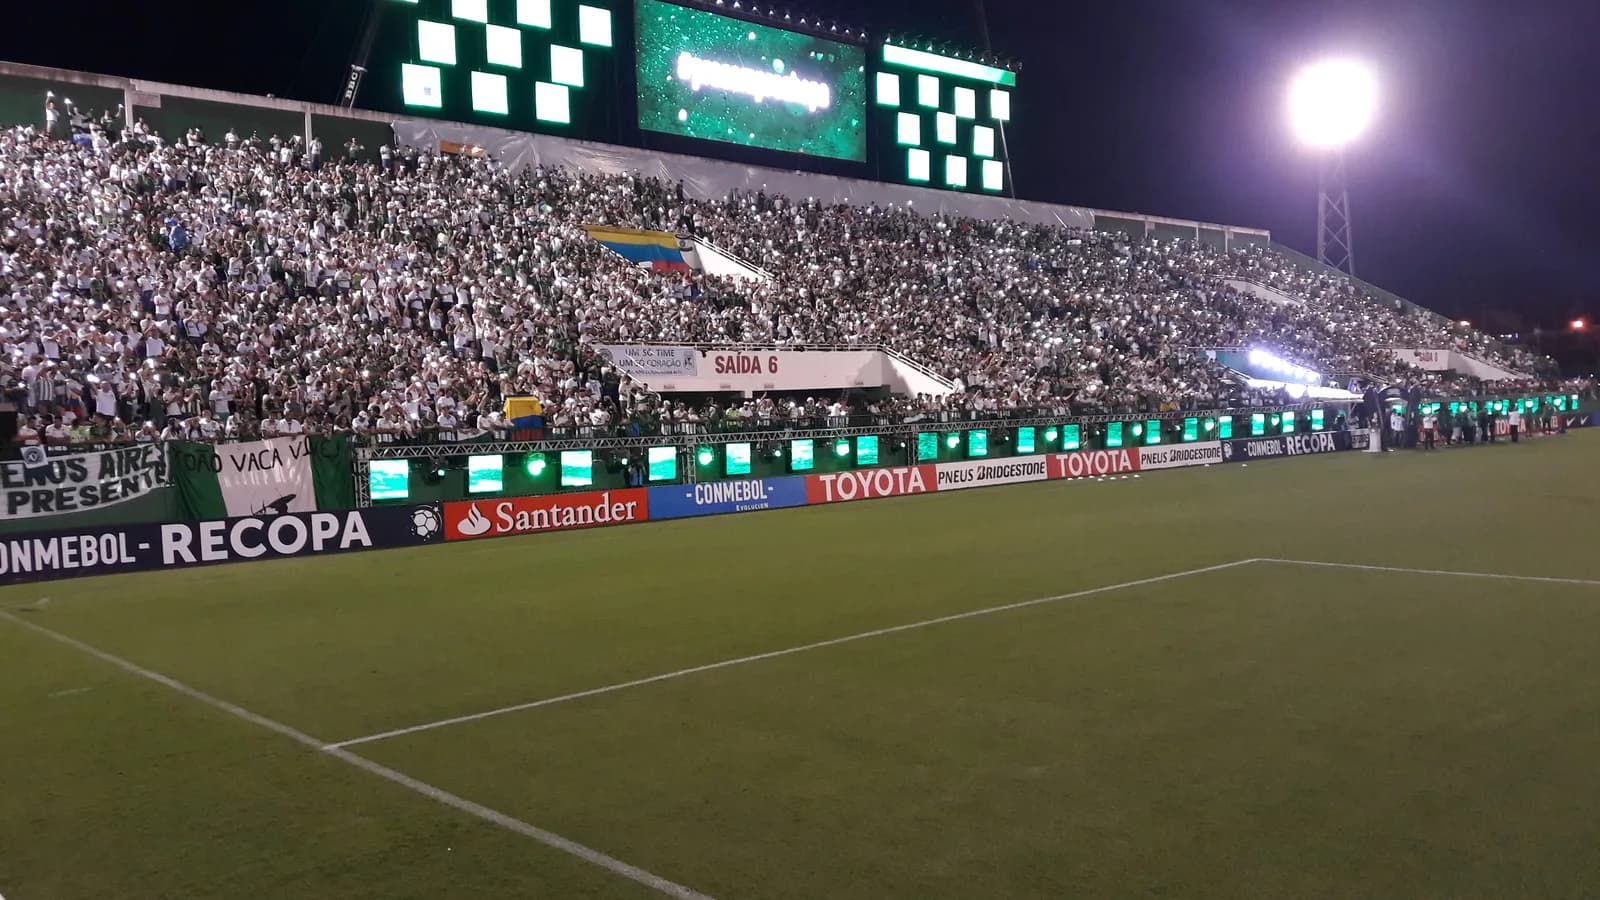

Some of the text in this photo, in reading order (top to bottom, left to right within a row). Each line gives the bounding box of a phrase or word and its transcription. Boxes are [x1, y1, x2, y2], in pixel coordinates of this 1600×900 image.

[656, 349, 675, 357] TIME
[715, 352, 778, 374] SAÍDA 6
[1141, 446, 1221, 465] PNEUS BRIDGESTONE
[1247, 439, 1283, 457] CONMEBOL
[1286, 432, 1336, 456] RECOPA
[231, 448, 283, 473] VACA
[938, 461, 1046, 485] PNEUS BRIDGESTONE
[1056, 449, 1132, 477] TOYOTA
[694, 479, 768, 505] CONMEBOL
[819, 466, 926, 502] TOYOTA
[496, 493, 637, 533] Santander
[161, 510, 373, 565] RECOPA
